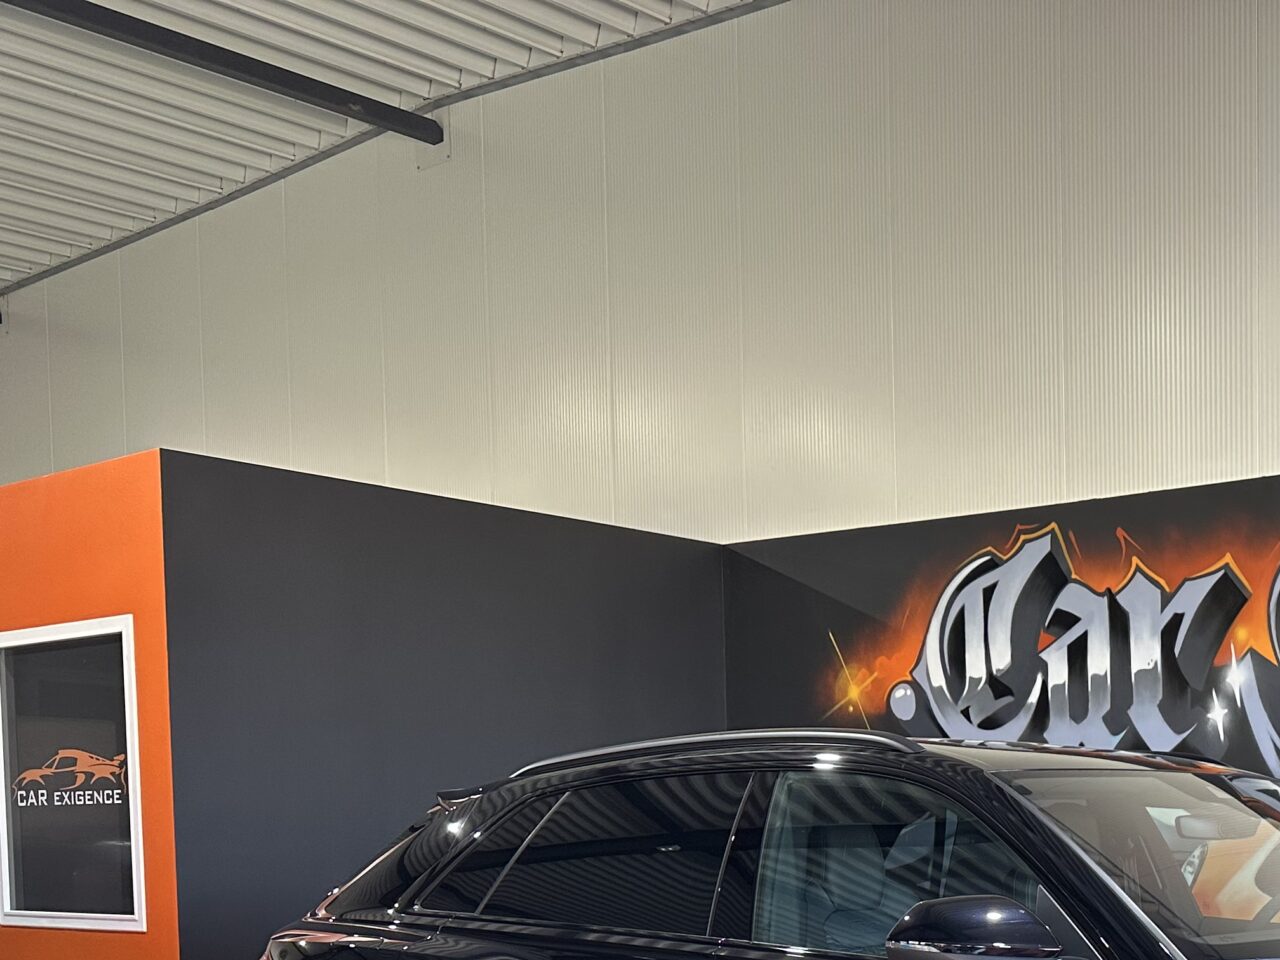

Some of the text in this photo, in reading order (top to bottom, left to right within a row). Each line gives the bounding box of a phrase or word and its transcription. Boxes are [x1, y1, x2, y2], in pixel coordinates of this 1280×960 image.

[911, 530, 1236, 752] Car
[17, 789, 122, 806] CAR EXIGENCE
